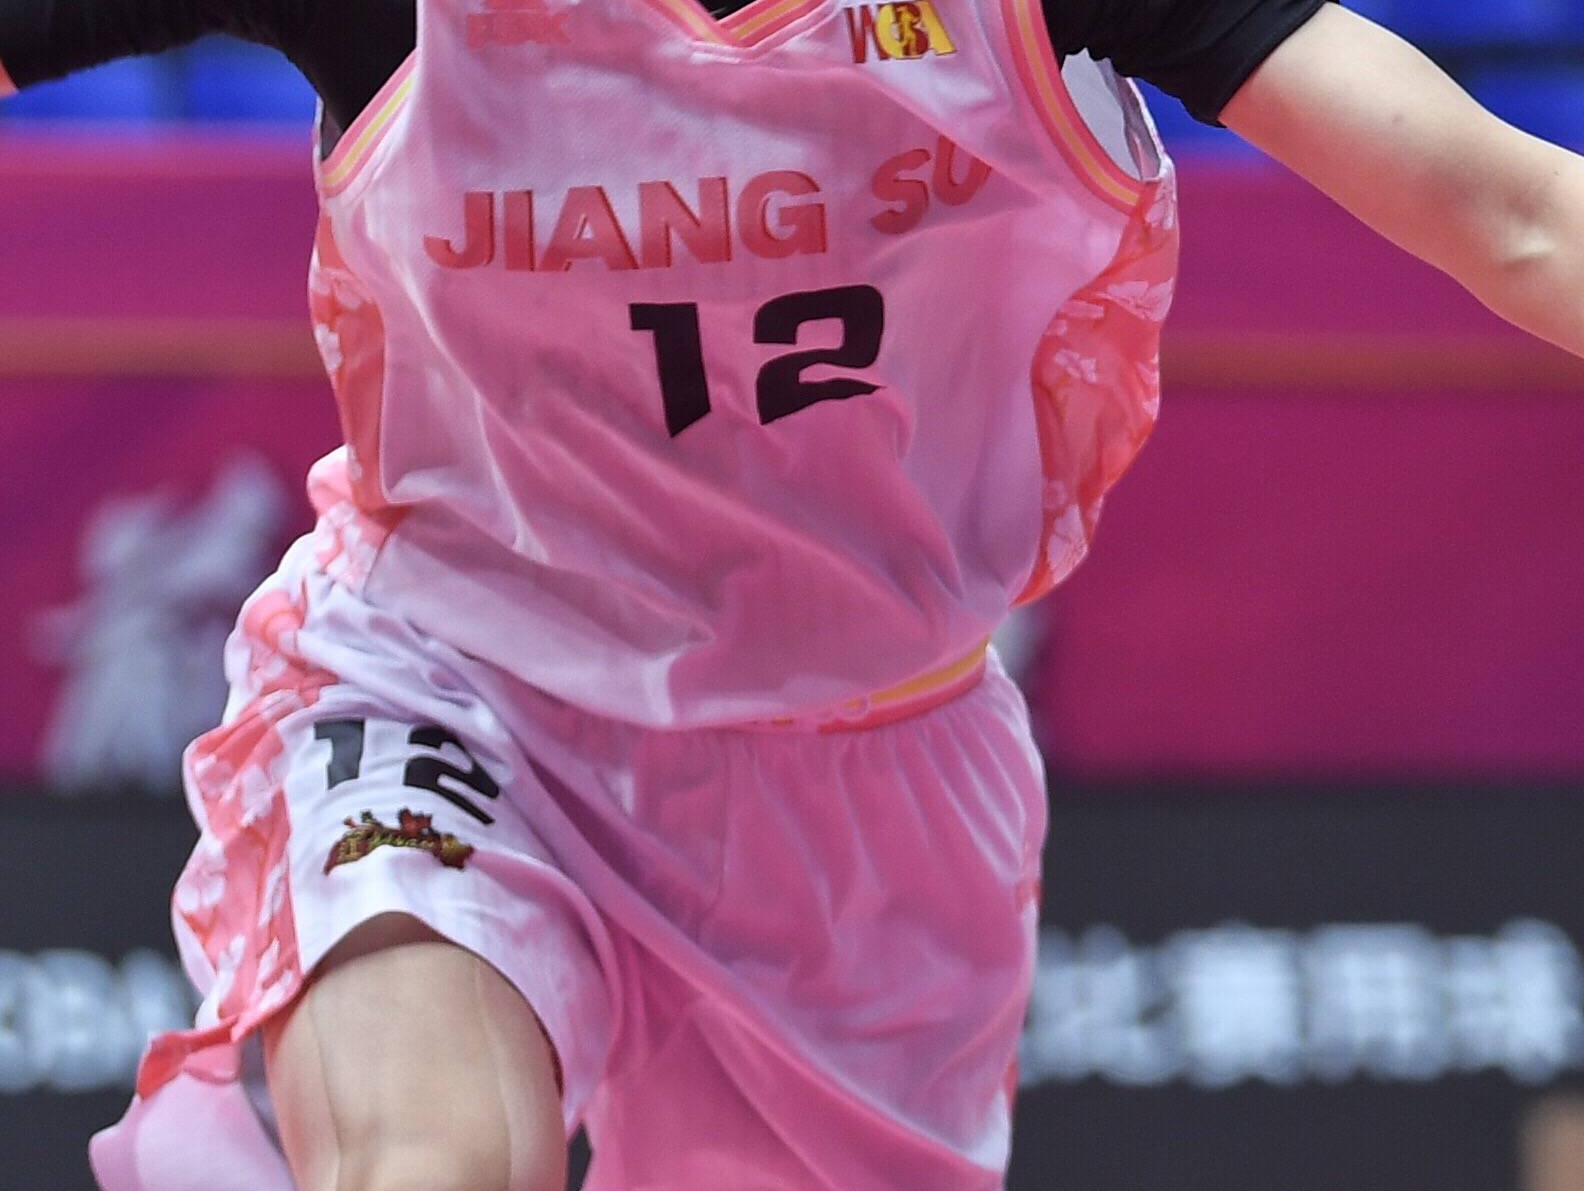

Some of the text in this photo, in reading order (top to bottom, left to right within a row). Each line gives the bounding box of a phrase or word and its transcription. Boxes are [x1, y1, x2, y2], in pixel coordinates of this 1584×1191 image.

[422, 135, 994, 273] JIANG SU
[629, 283, 887, 438] 12
[313, 718, 500, 826] 12
